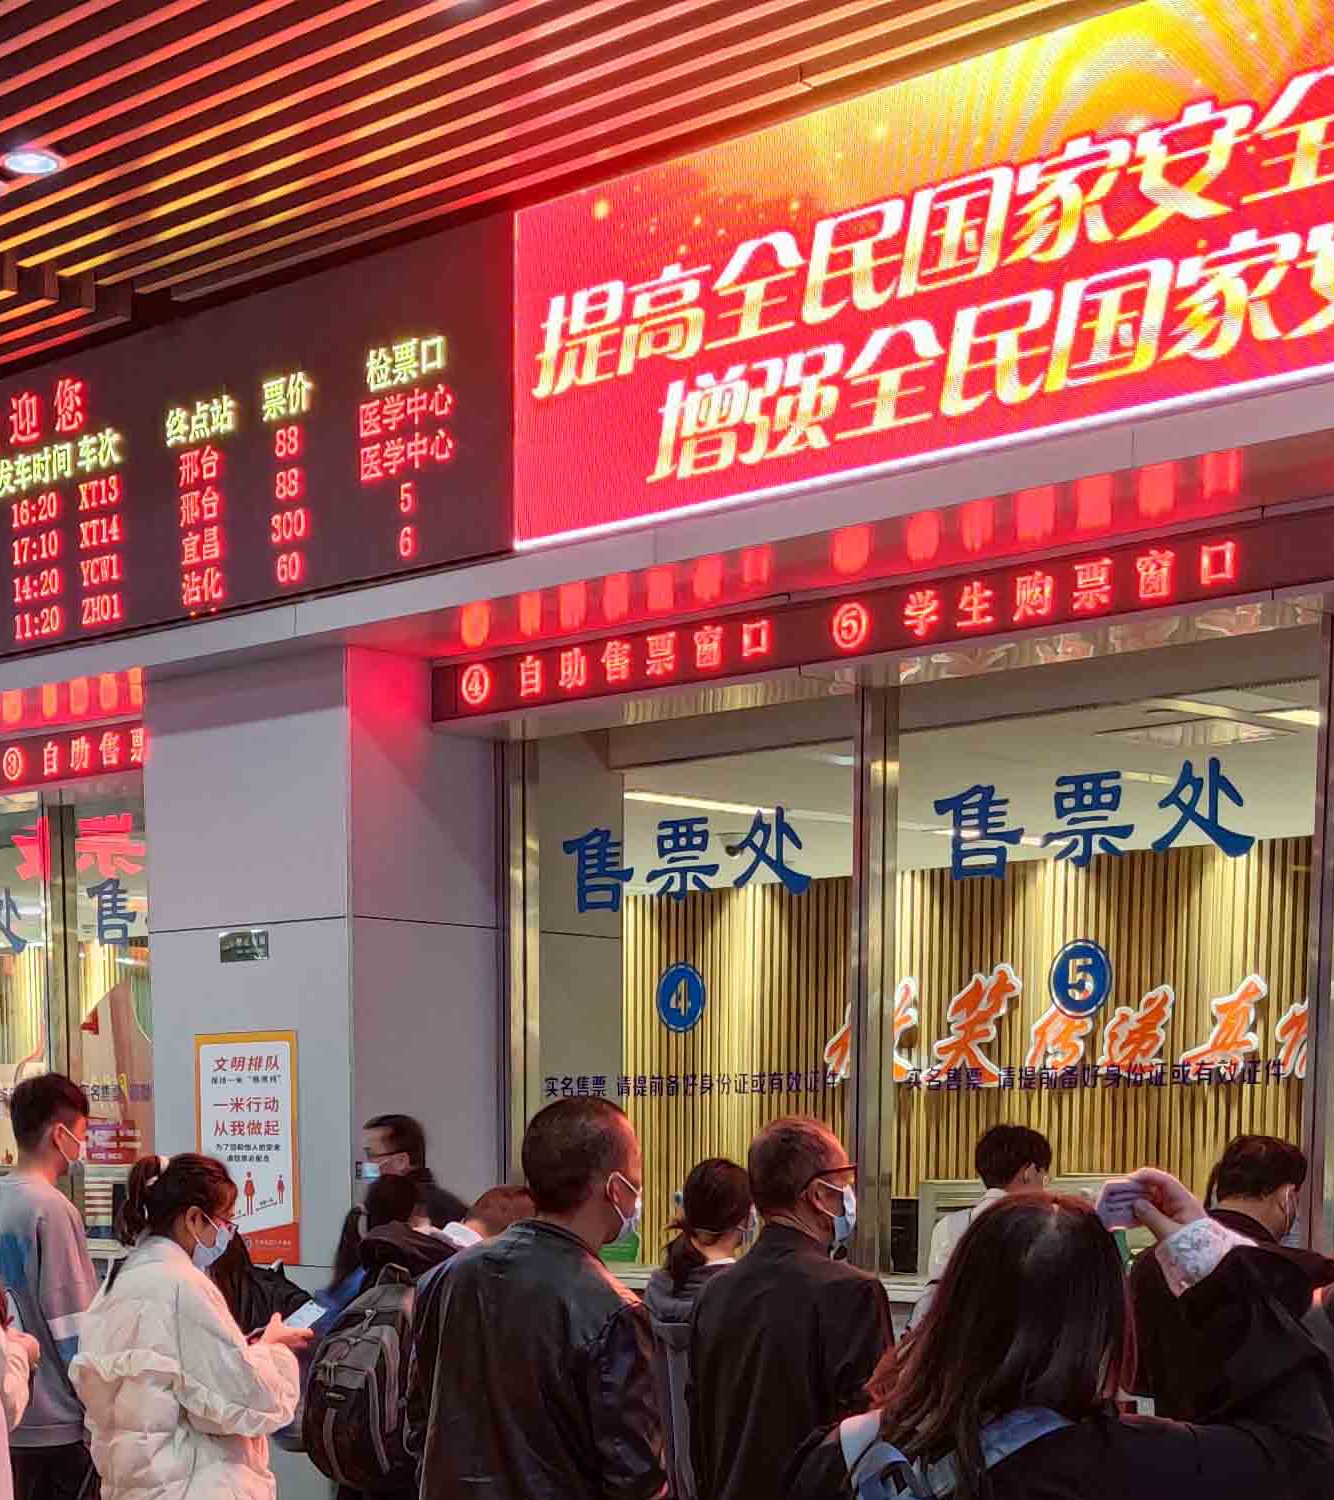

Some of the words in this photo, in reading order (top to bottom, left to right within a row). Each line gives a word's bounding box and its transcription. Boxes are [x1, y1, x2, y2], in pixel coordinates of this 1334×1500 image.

[166, 395, 235, 446] 终点站
[262, 371, 312, 422] 票价
[366, 336, 445, 392] 检票口
[11, 491, 58, 529] 16:20
[78, 475, 118, 511] XT13
[274, 425, 299, 457] 88
[359, 384, 452, 437] 医学中心
[77, 427, 122, 471] 车次
[12, 529, 59, 566] 17:10
[79, 513, 120, 549] XT14
[275, 468, 300, 499] 88
[360, 429, 453, 481] 医学中心
[13, 567, 59, 604] 14:20
[181, 525, 220, 565] 宜昌
[271, 509, 306, 543] 300
[399, 482, 413, 512] 5
[15, 604, 60, 641] 11:20
[277, 552, 300, 583] 60
[399, 526, 413, 557] 6
[903, 540, 1238, 638] 学生购票窗口
[519, 618, 771, 698] 自助售票窗口
[563, 806, 811, 913] 售票处
[934, 756, 1257, 880] 售票处
[87, 878, 149, 948] 售
[213, 1055, 281, 1073] 文明排队
[213, 1096, 280, 1113] 一米行动
[544, 1075, 607, 1097] 实名售票
[617, 1069, 840, 1097] 请提前备好身份证或有效证件
[906, 1066, 984, 1091] 实名售票
[999, 1058, 1286, 1090] 请提前备好身份证或有效证件
[213, 1120, 280, 1137] 从我做起
